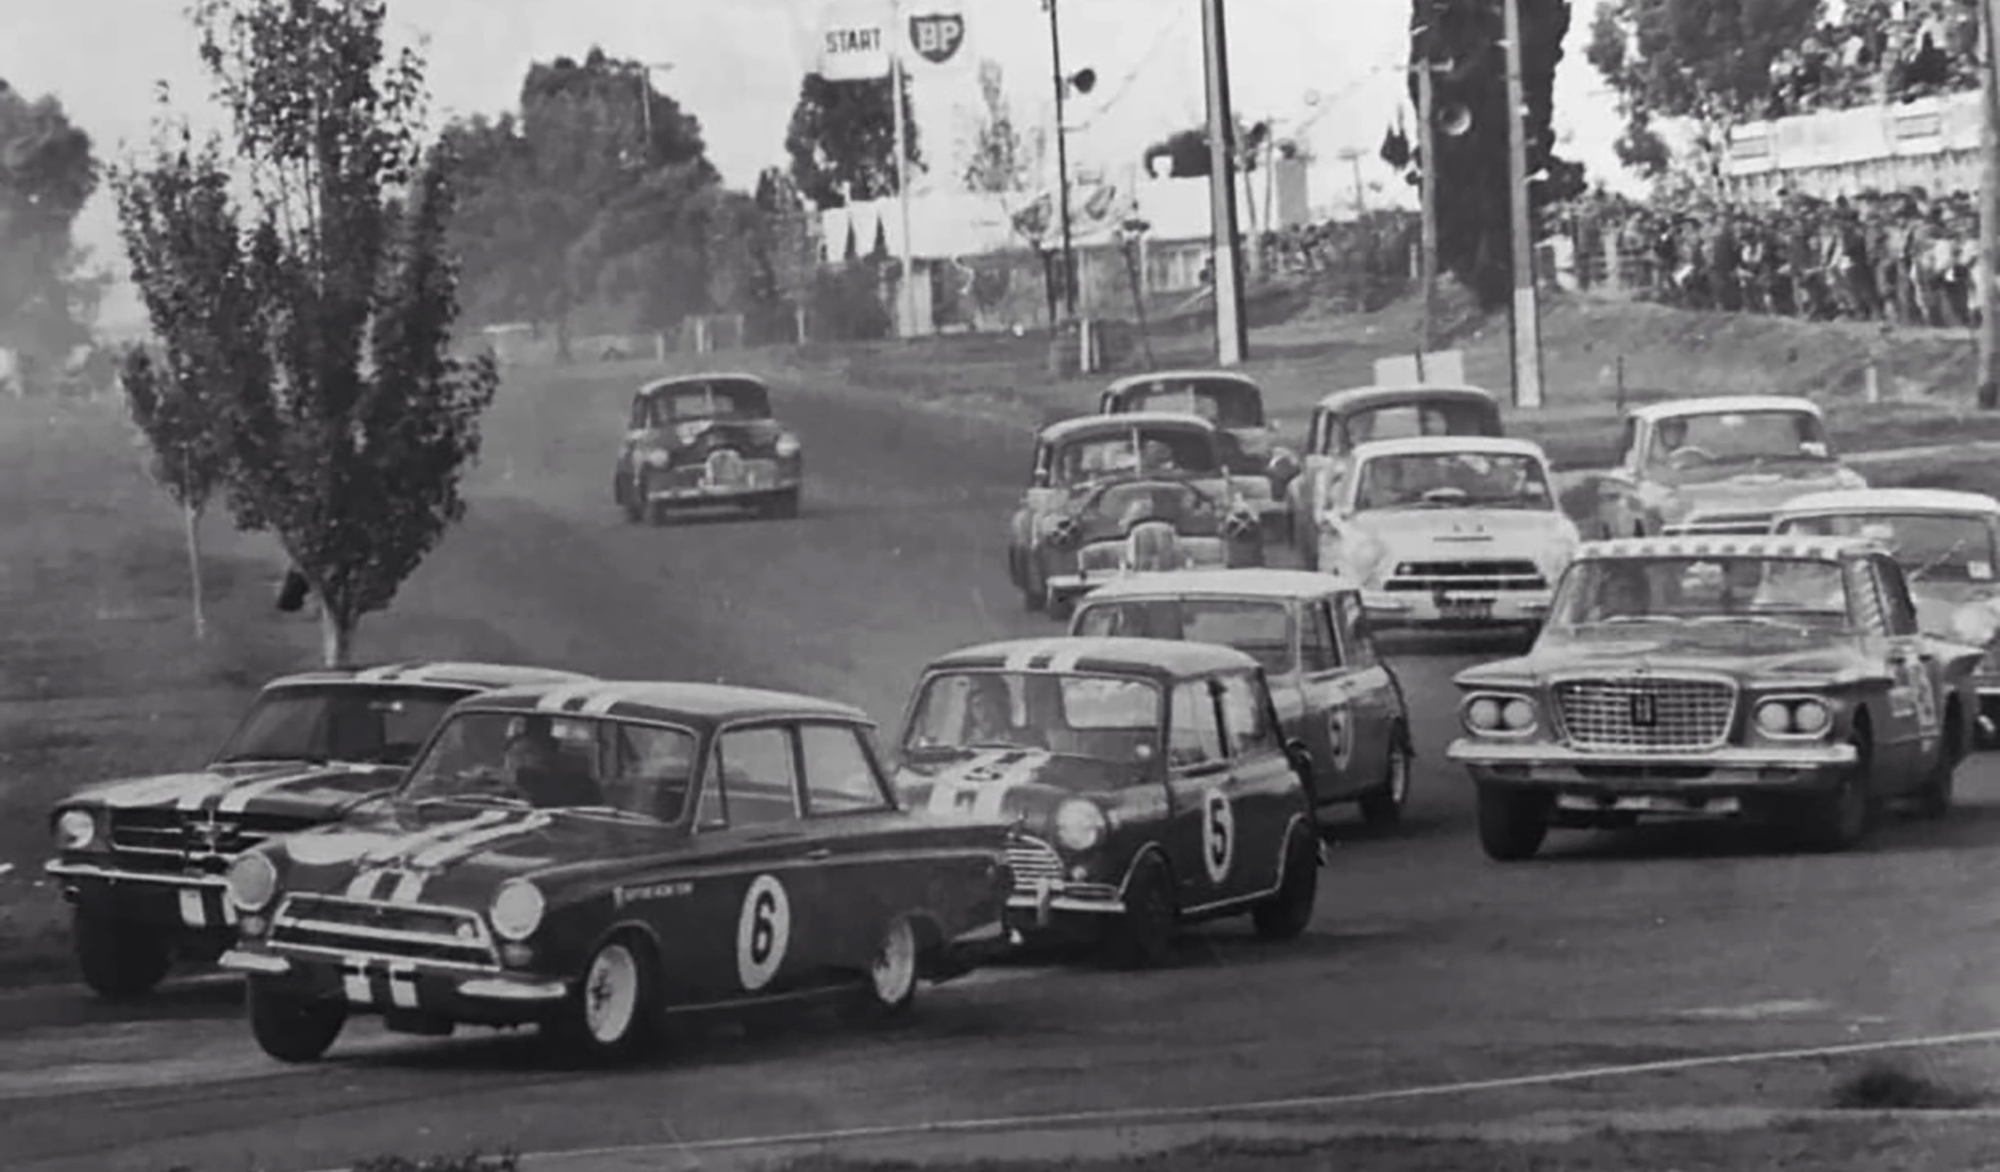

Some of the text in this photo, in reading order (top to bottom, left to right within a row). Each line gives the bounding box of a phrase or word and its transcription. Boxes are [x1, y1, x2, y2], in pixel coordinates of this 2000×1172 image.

[825, 28, 881, 53] START
[918, 20, 959, 51] BP
[1211, 797, 1227, 866] 5
[752, 889, 777, 966] 6
